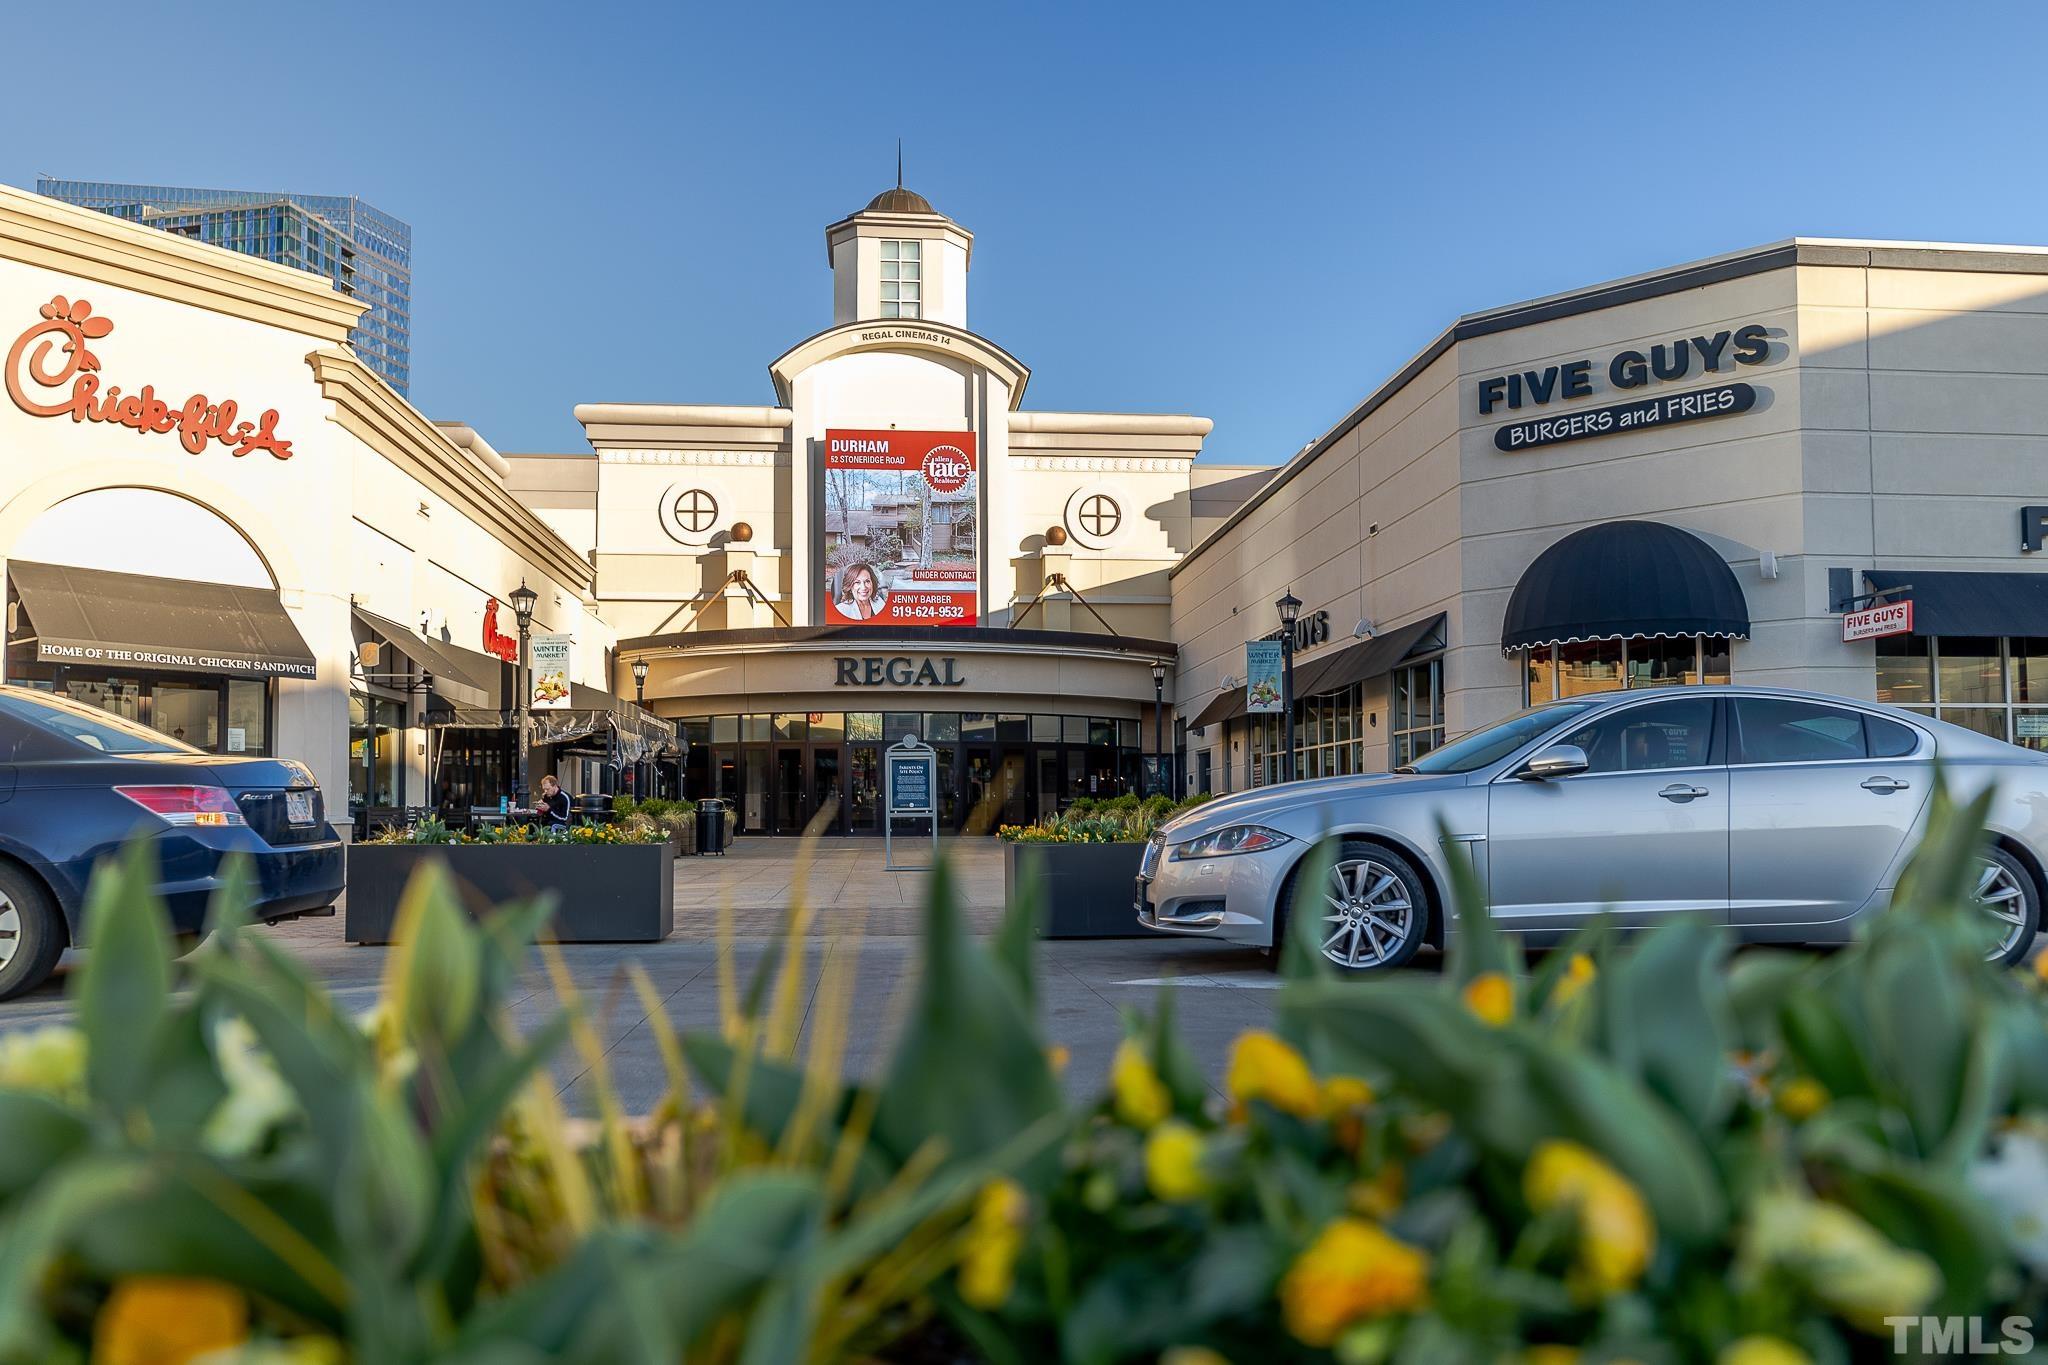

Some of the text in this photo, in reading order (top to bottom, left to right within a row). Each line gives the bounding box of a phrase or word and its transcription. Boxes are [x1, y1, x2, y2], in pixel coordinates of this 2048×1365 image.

[861, 330, 950, 345] REGAL CINEMAS 14
[5, 296, 293, 460] Chick-fil-A
[1478, 324, 1770, 415] FIVE GUYS
[1510, 389, 1735, 445] BURGERS and FRIES
[831, 439, 889, 453] DURHAM
[830, 455, 906, 464] 52 STONERIDGE ROAD
[926, 457, 967, 478] tate
[914, 571, 976, 580] UNDER CONTRACT
[892, 595, 952, 604] JENNY BARBER
[892, 605, 964, 617] 919-624-9532
[1848, 607, 1904, 628] FIVE GUYS
[1292, 610, 1330, 653] UYS
[41, 644, 316, 675] HOME OF THE ORIGINAL CHICKEN SANDWICH
[834, 657, 965, 687] REGAL
